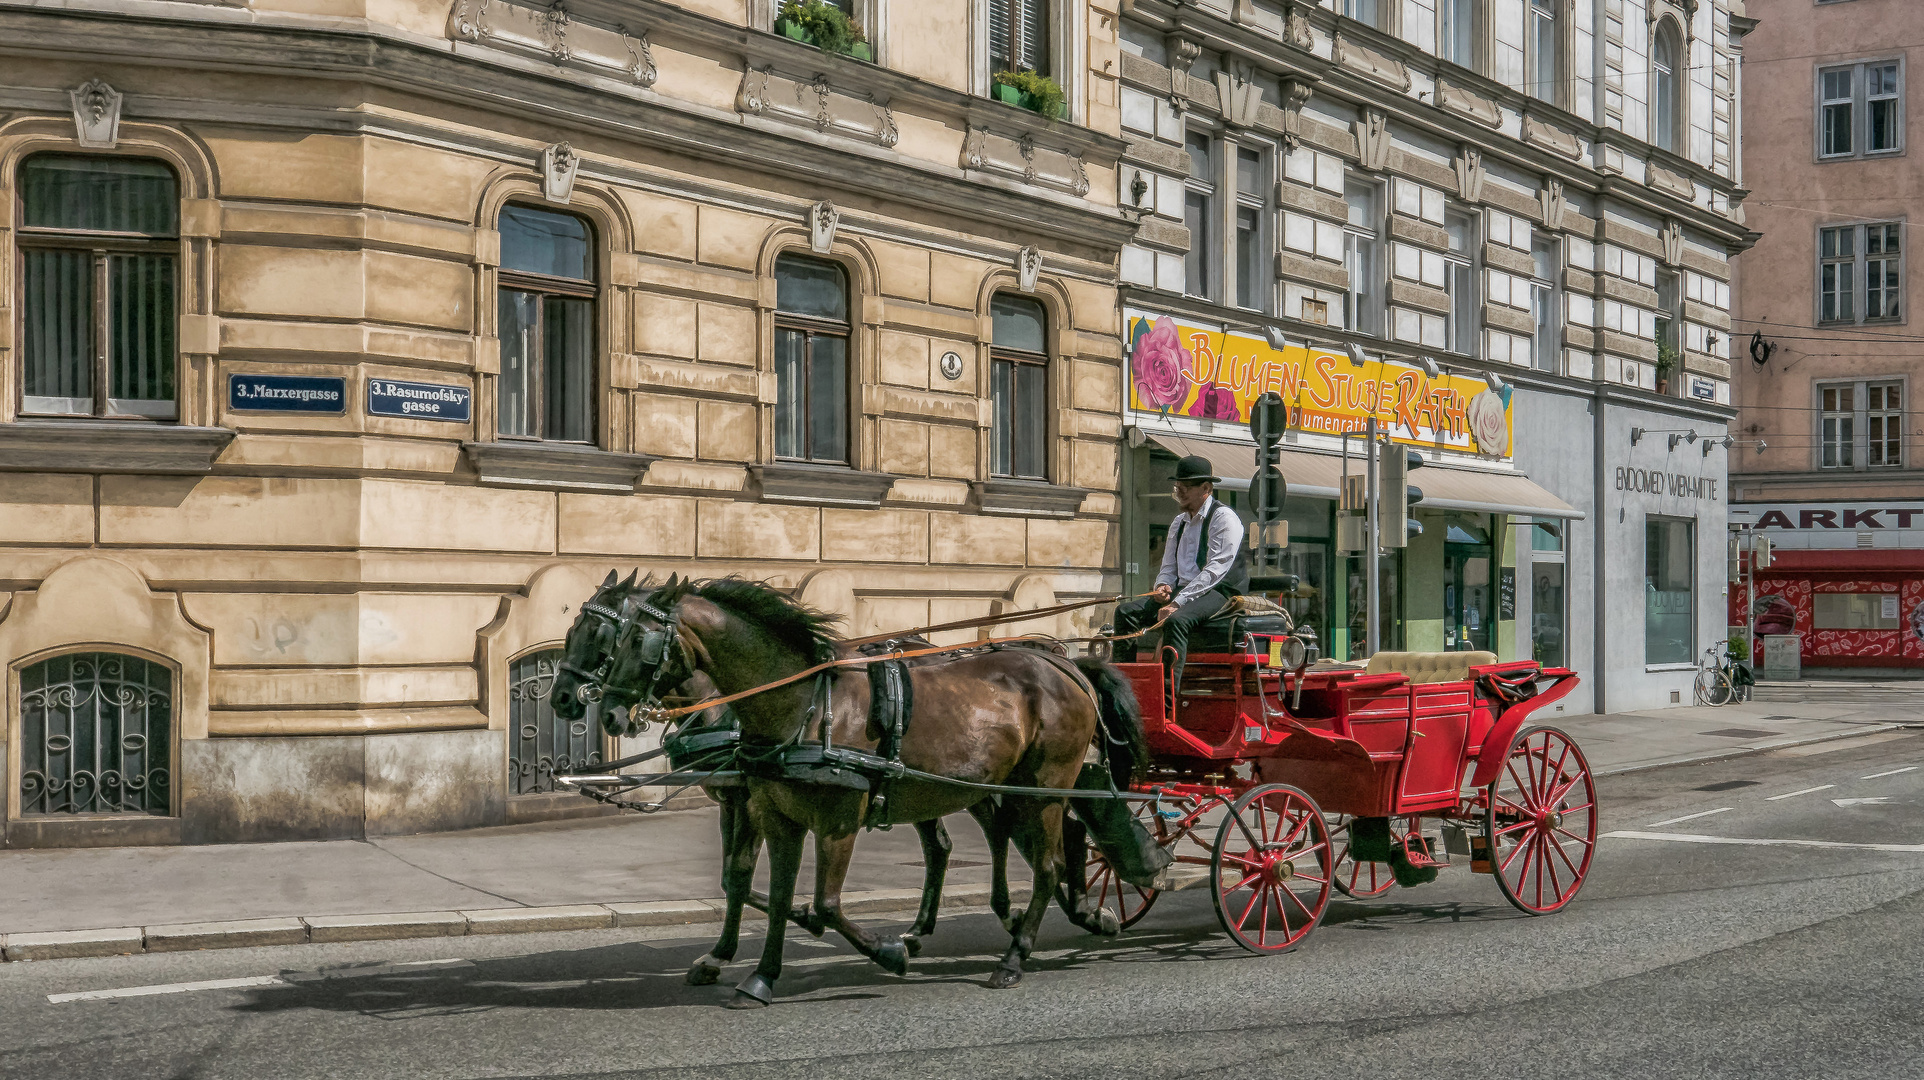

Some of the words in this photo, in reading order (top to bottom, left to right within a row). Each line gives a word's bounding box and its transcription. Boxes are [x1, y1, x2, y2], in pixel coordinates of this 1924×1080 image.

[948, 354, 956, 371] 8
[402, 401, 440, 413] gasse
[1394, 370, 1467, 440] RATH
[1615, 466, 1664, 495] ENDOMED
[1728, 509, 1924, 529] ARKT
